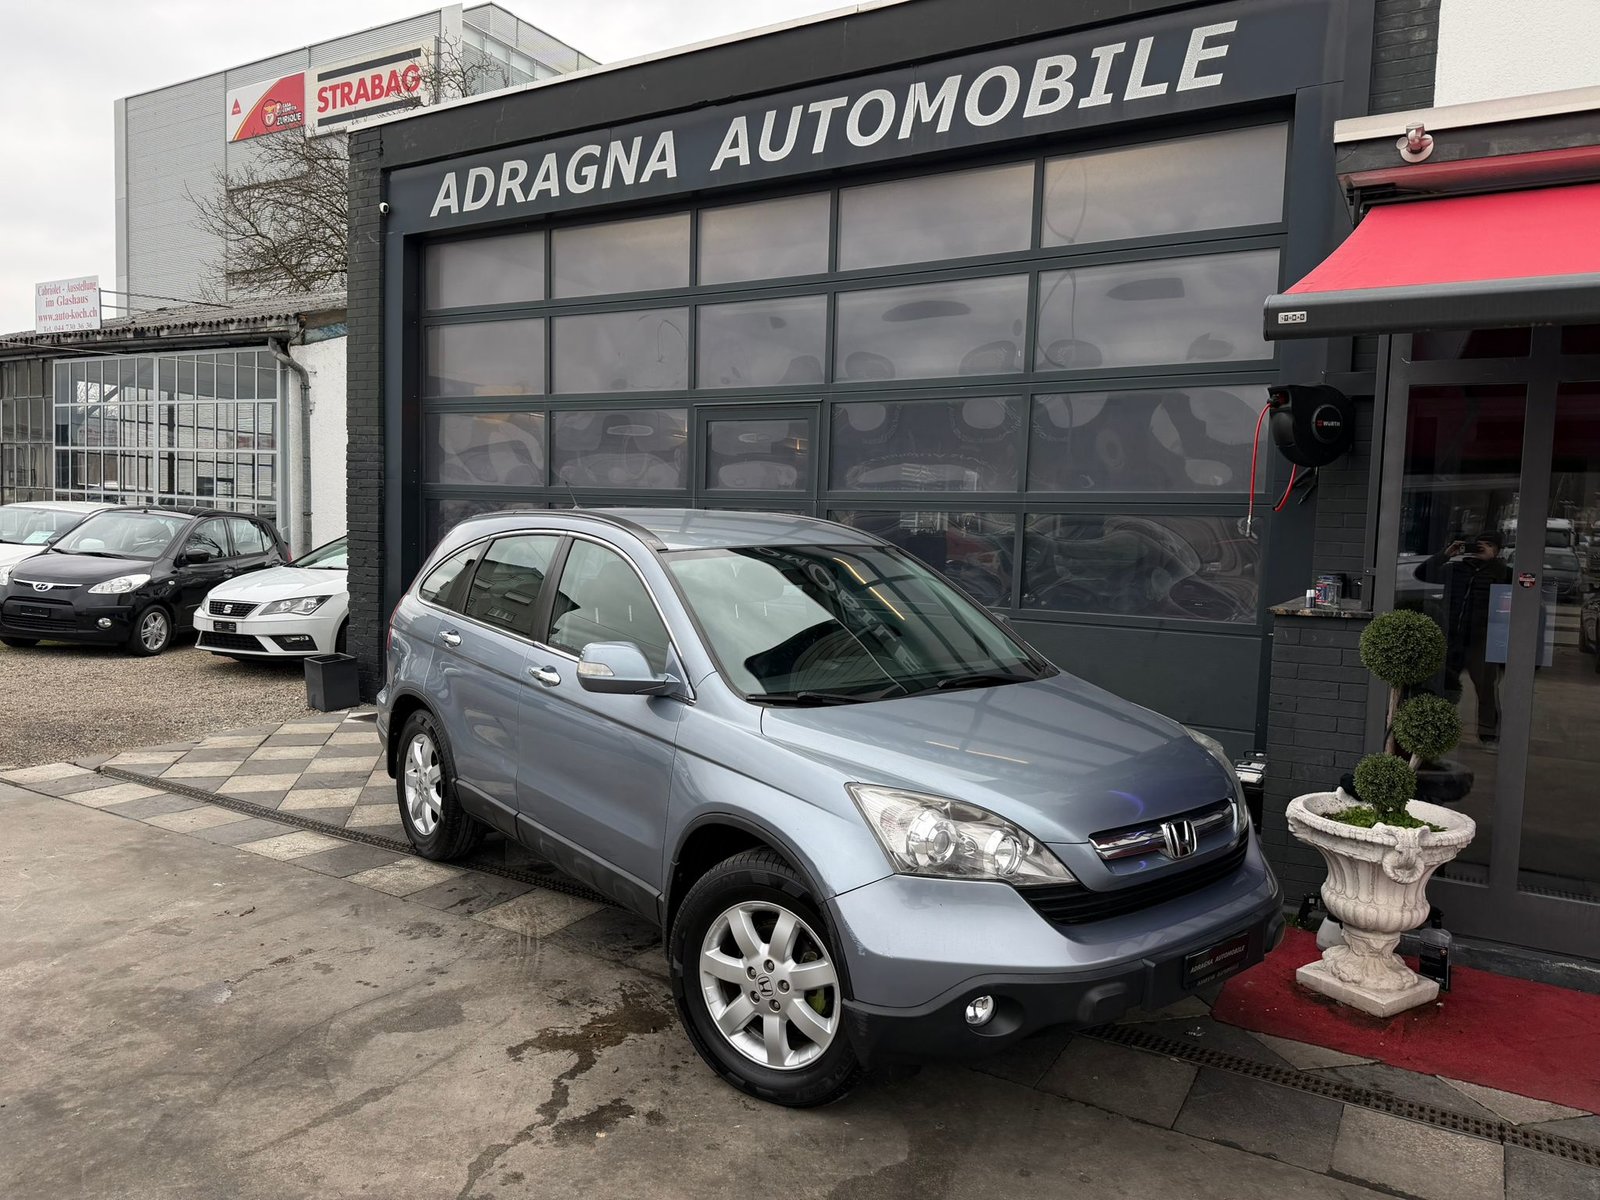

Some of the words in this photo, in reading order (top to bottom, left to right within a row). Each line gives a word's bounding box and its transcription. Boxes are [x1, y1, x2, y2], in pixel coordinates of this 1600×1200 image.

[317, 64, 421, 113] STRABAG
[429, 130, 677, 218] ADRAGNA
[709, 19, 1238, 171] AUTOMOBILE
[37, 284, 61, 296] Cabriolet
[67, 280, 97, 293] Ausstellung
[45, 297, 55, 308] im
[56, 294, 89, 307] Glashaus
[38, 307, 98, 322] www.auto-koch.ch
